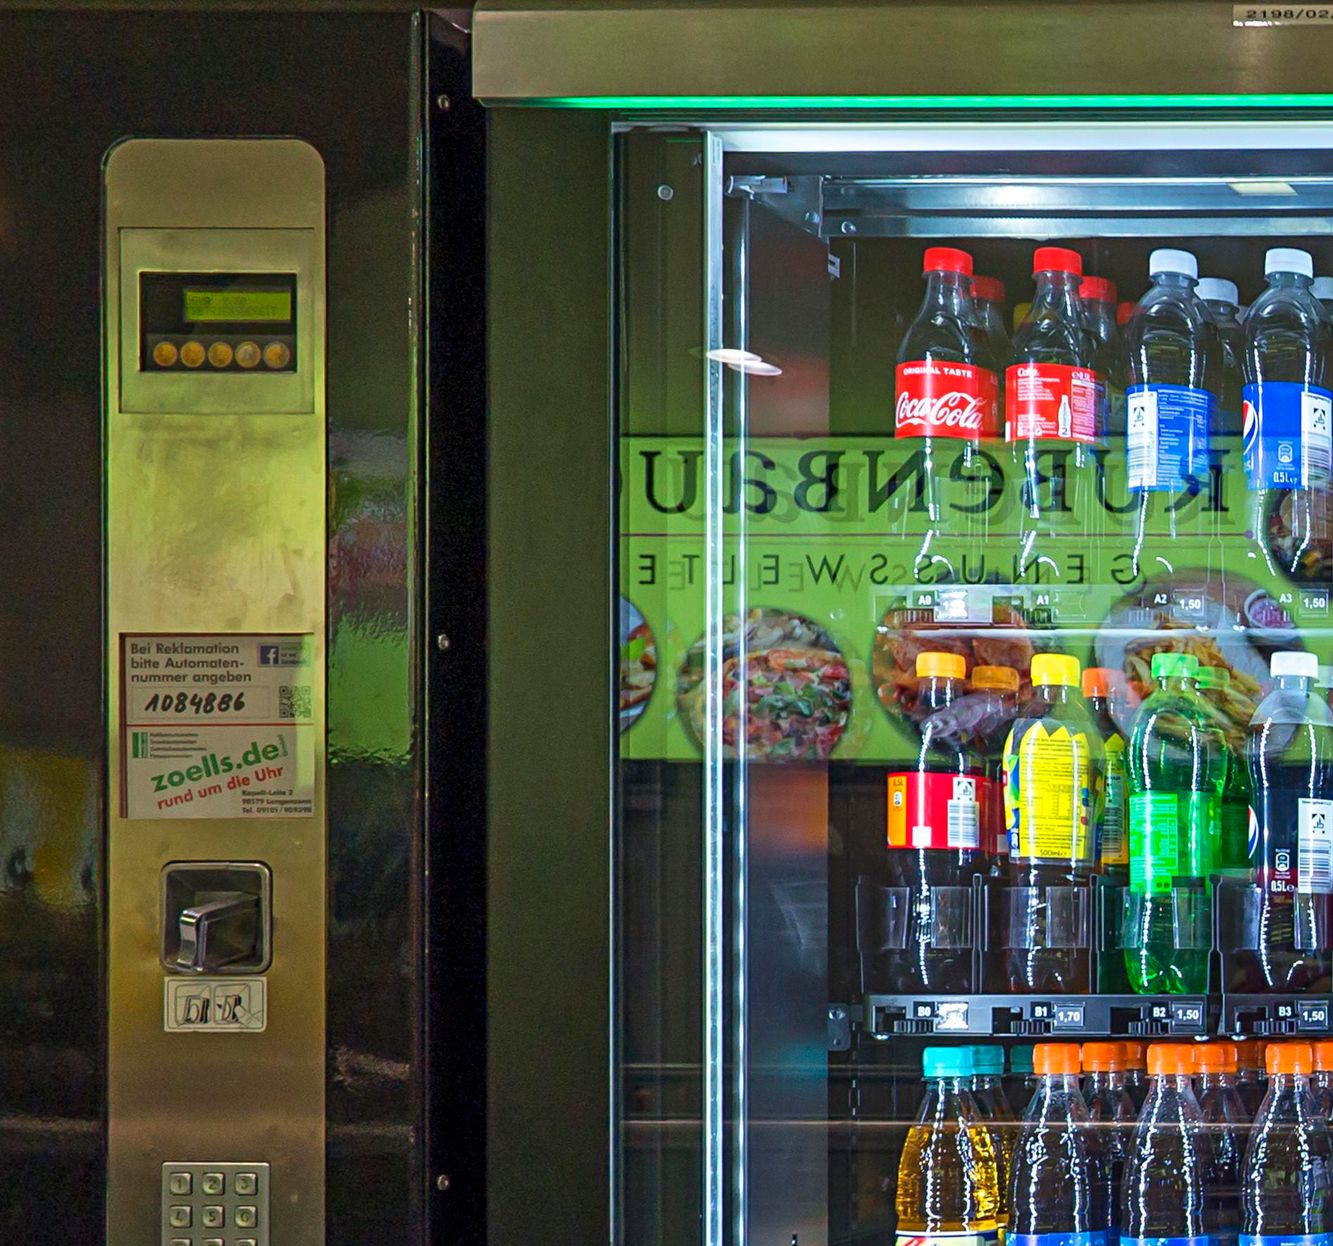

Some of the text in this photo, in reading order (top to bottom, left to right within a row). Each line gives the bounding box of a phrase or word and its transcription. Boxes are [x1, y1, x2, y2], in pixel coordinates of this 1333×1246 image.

[943, 368, 973, 378] TASTE
[896, 391, 983, 430] Coca-Cola
[1154, 594, 1201, 610] A2 1,50
[130, 643, 239, 654] Bei Reklamation
[130, 658, 244, 669] bitte Automaten-
[131, 671, 252, 685] nummer angeben
[151, 741, 280, 792] zoells.de
[157, 766, 284, 811] rund um die Uhr
